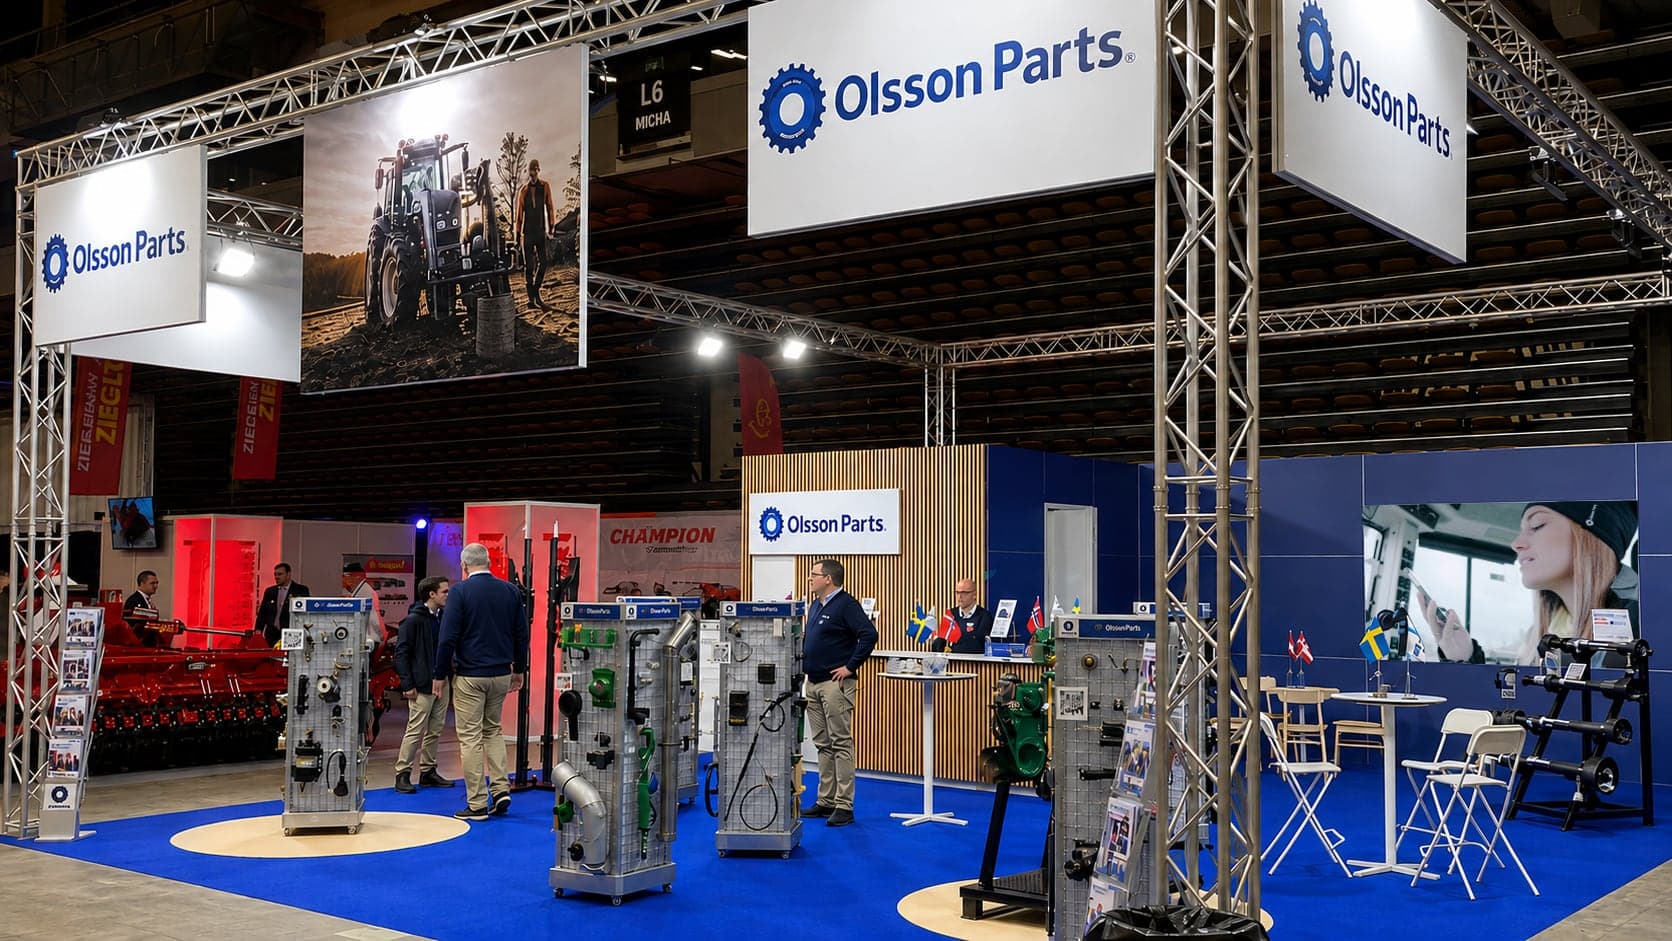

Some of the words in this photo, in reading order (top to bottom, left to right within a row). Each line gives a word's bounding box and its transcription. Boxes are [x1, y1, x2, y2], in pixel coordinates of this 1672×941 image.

[640, 79, 664, 107] L6
[834, 70, 983, 121] Olsson
[1339, 50, 1404, 132] Olsson
[1406, 92, 1451, 158] Parts
[635, 110, 671, 131] MICHA
[72, 242, 132, 274] Olsson
[135, 226, 186, 262] Parts
[258, 379, 279, 422] ZIE
[609, 527, 716, 545] CHAMPION
[787, 515, 838, 533] Olsson
[840, 514, 884, 533] Parts
